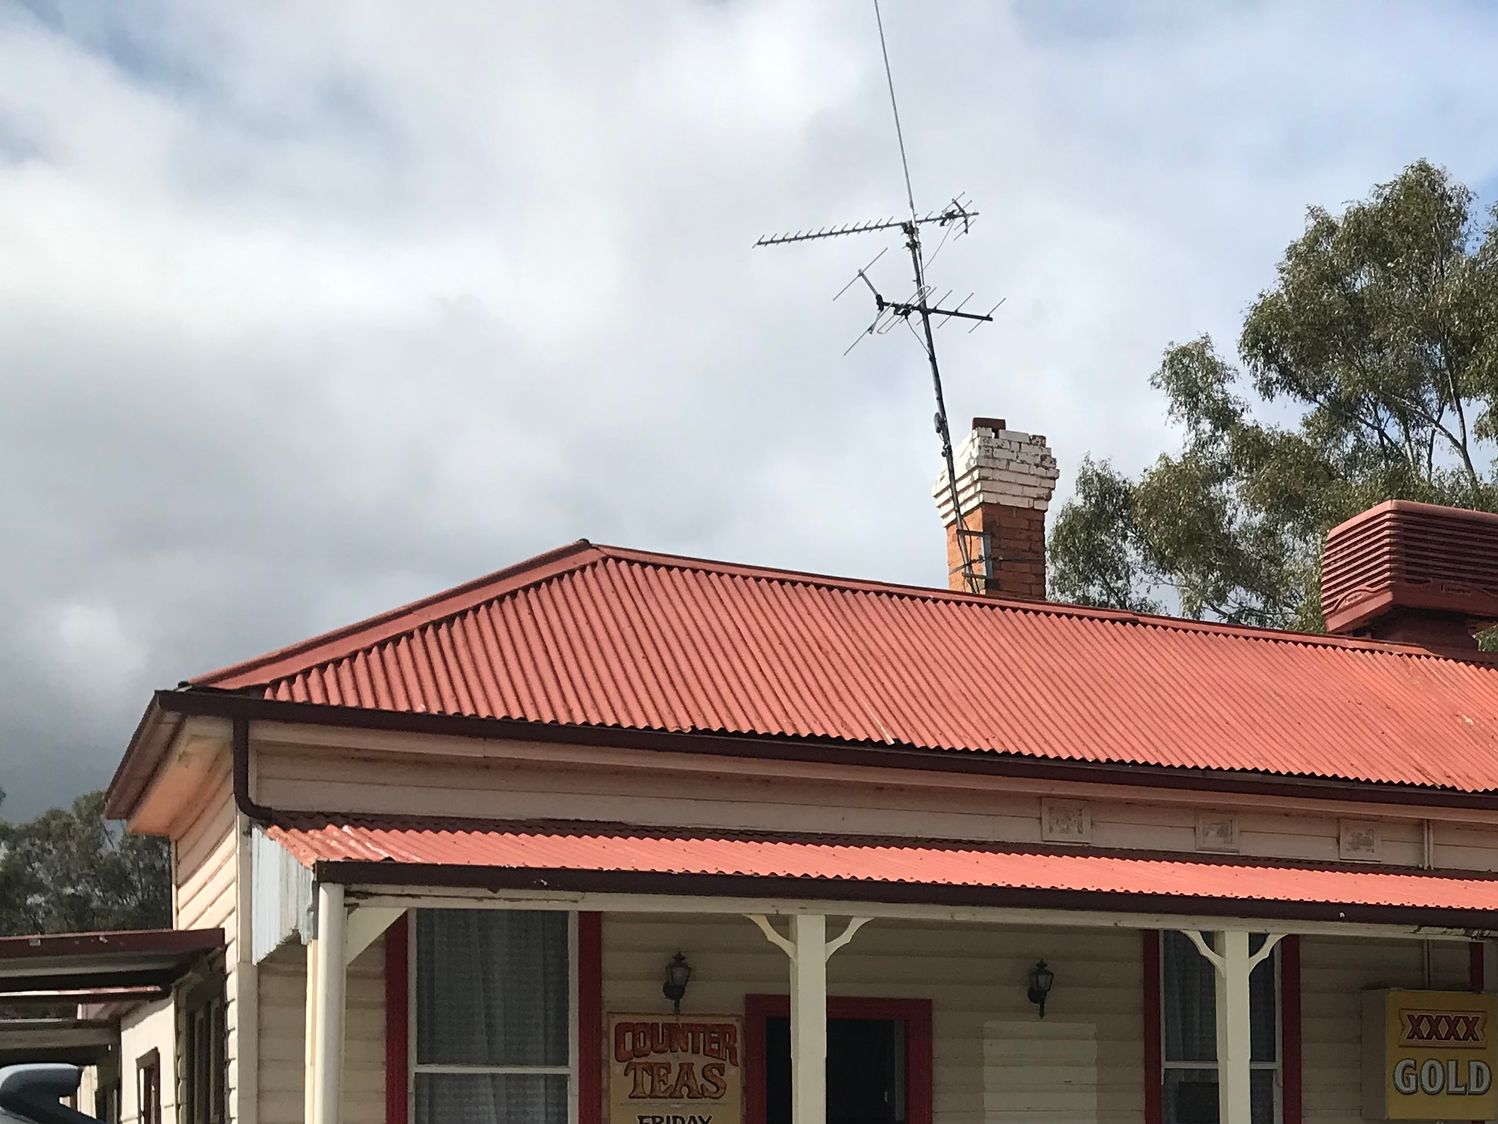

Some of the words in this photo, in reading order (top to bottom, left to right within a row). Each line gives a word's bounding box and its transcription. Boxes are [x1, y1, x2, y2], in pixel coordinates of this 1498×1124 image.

[614, 1022, 739, 1067] COUNTER
[1406, 1014, 1480, 1041] XXXX
[624, 1061, 728, 1099] TEAS
[1393, 1057, 1492, 1095] GOLD
